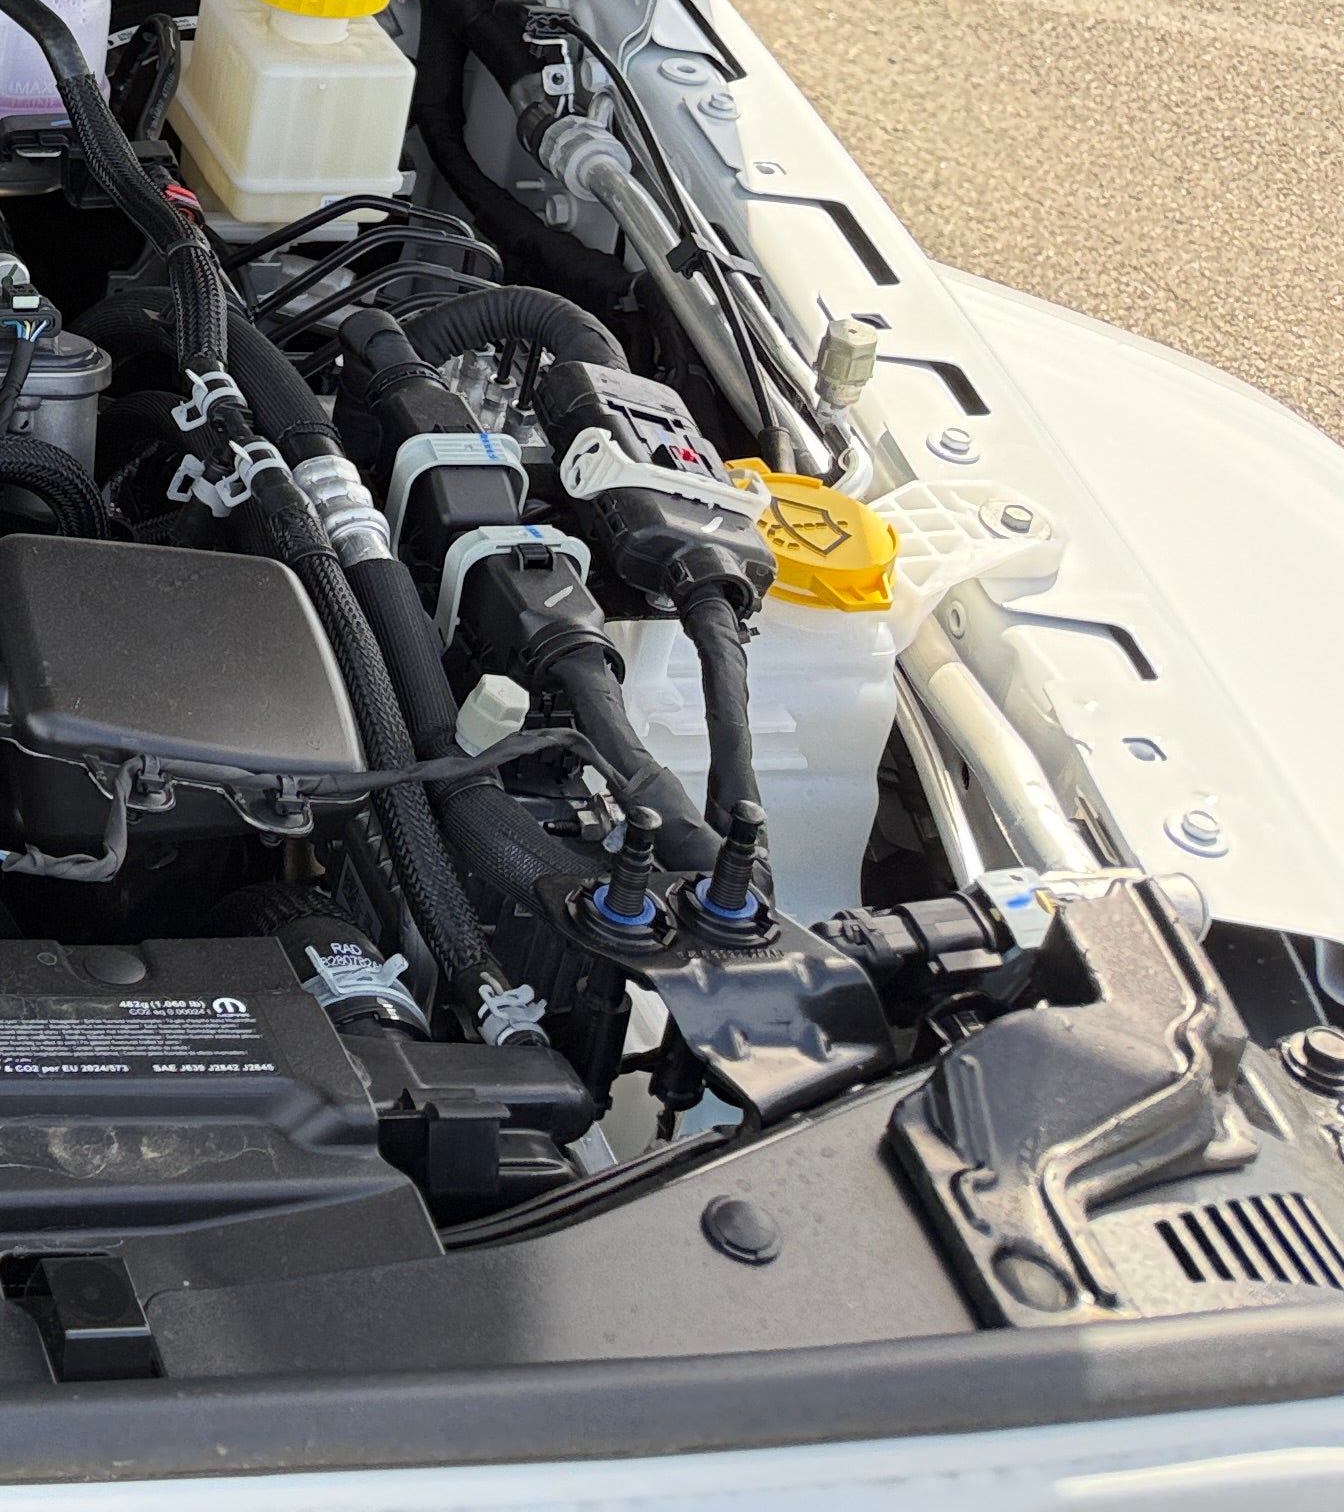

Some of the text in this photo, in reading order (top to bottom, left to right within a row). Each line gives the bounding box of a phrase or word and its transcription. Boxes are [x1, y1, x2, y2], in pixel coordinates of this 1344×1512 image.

[330, 942, 363, 956] RAD
[14, 1064, 40, 1073] CO2
[41, 1064, 61, 1074] per
[62, 1064, 79, 1073] EU
[152, 1064, 178, 1073] SAE
